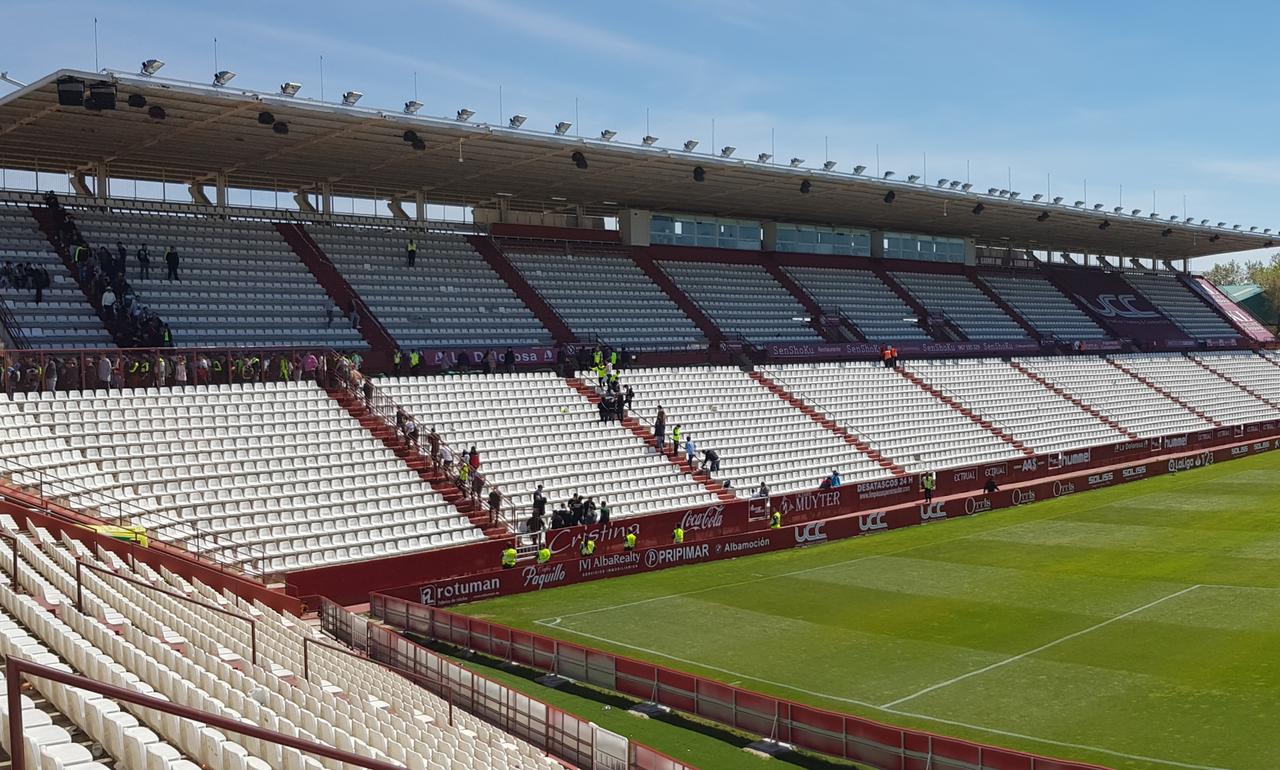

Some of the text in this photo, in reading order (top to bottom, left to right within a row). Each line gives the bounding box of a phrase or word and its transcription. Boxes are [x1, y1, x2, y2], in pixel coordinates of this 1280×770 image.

[1062, 450, 1091, 466] hummel
[1088, 472, 1113, 484] SOLISS
[1122, 466, 1146, 477] SOLISS
[857, 478, 898, 493] DESATASCOS
[920, 502, 946, 519] UCC
[965, 496, 990, 515] Orris
[858, 512, 888, 531] UCC
[549, 522, 640, 554] Cristina
[794, 522, 828, 543] UCC
[724, 537, 769, 552] Albamoción
[593, 550, 641, 568] AlbaRealty
[658, 544, 709, 564] PRIPIMAR
[522, 563, 566, 591] Paquillo
[437, 578, 500, 599] rotuman
